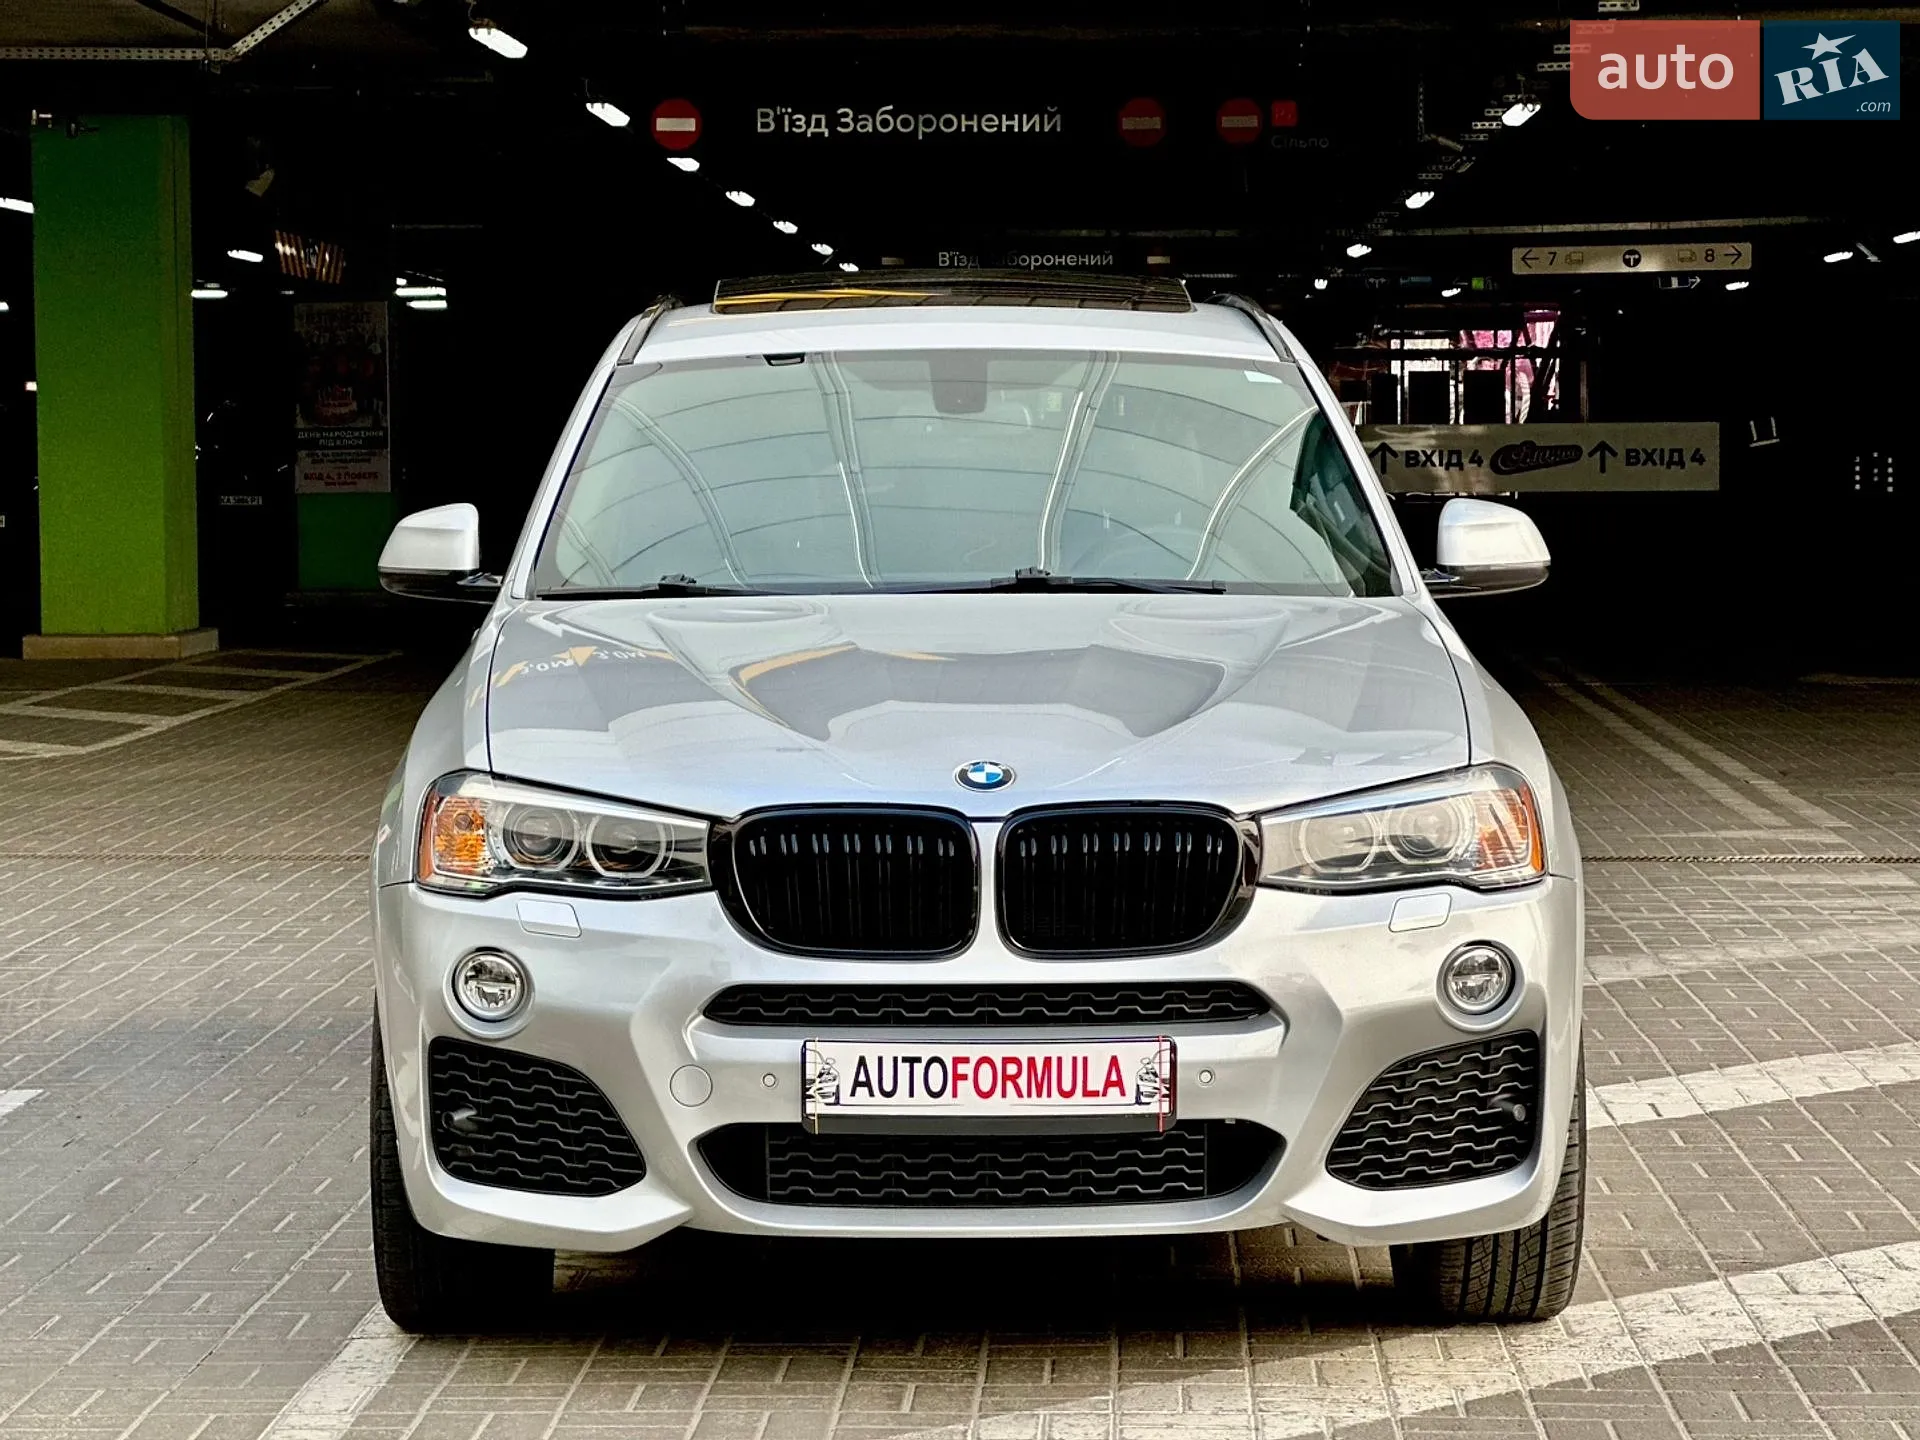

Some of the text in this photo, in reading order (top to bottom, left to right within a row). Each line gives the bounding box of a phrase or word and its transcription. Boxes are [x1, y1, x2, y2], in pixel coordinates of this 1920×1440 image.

[756, 105, 1062, 140] В'їзд Заборонений
[988, 250, 1114, 270] боронений
[1547, 251, 1558, 266] 7
[1704, 248, 1715, 263] 8
[1404, 448, 1464, 470] ВХІД
[1469, 449, 1484, 467] 4
[1625, 448, 1706, 470] ВХІД 4
[849, 1055, 1127, 1099] AUTOFORMULA
